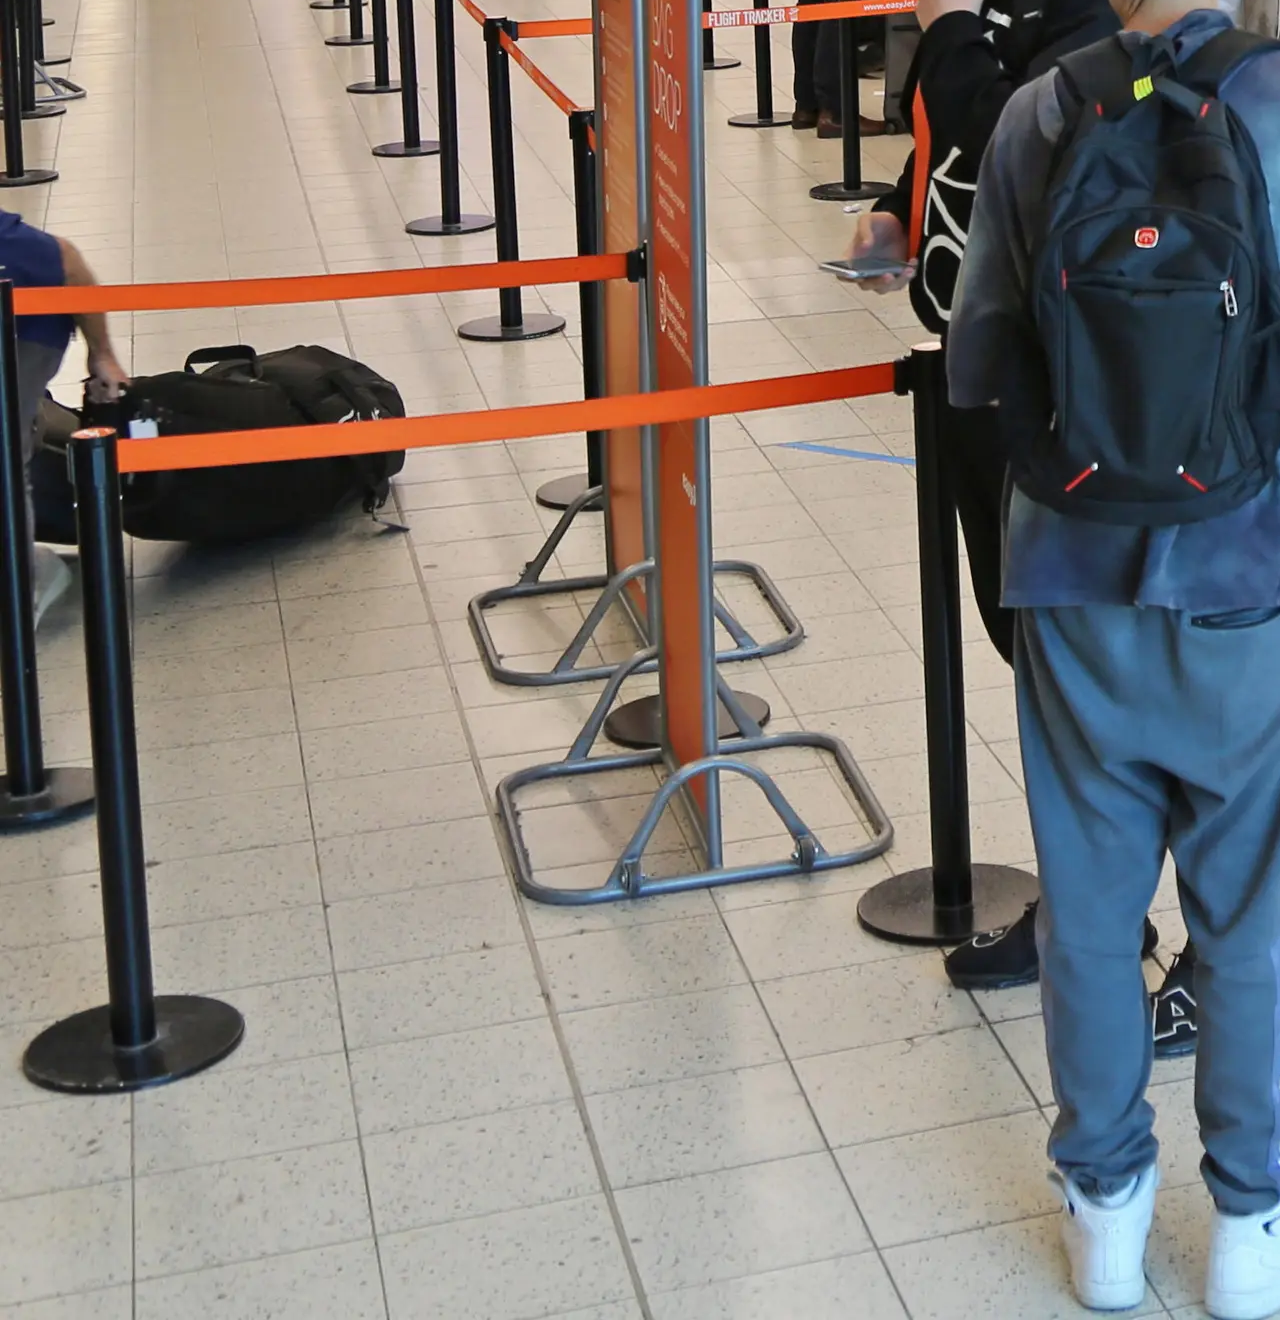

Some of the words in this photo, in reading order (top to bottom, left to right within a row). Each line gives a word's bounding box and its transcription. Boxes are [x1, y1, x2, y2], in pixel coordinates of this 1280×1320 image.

[708, 12, 741, 27] FLIGHT
[743, 8, 786, 25] TRACKER
[653, 60, 682, 134] DROP
